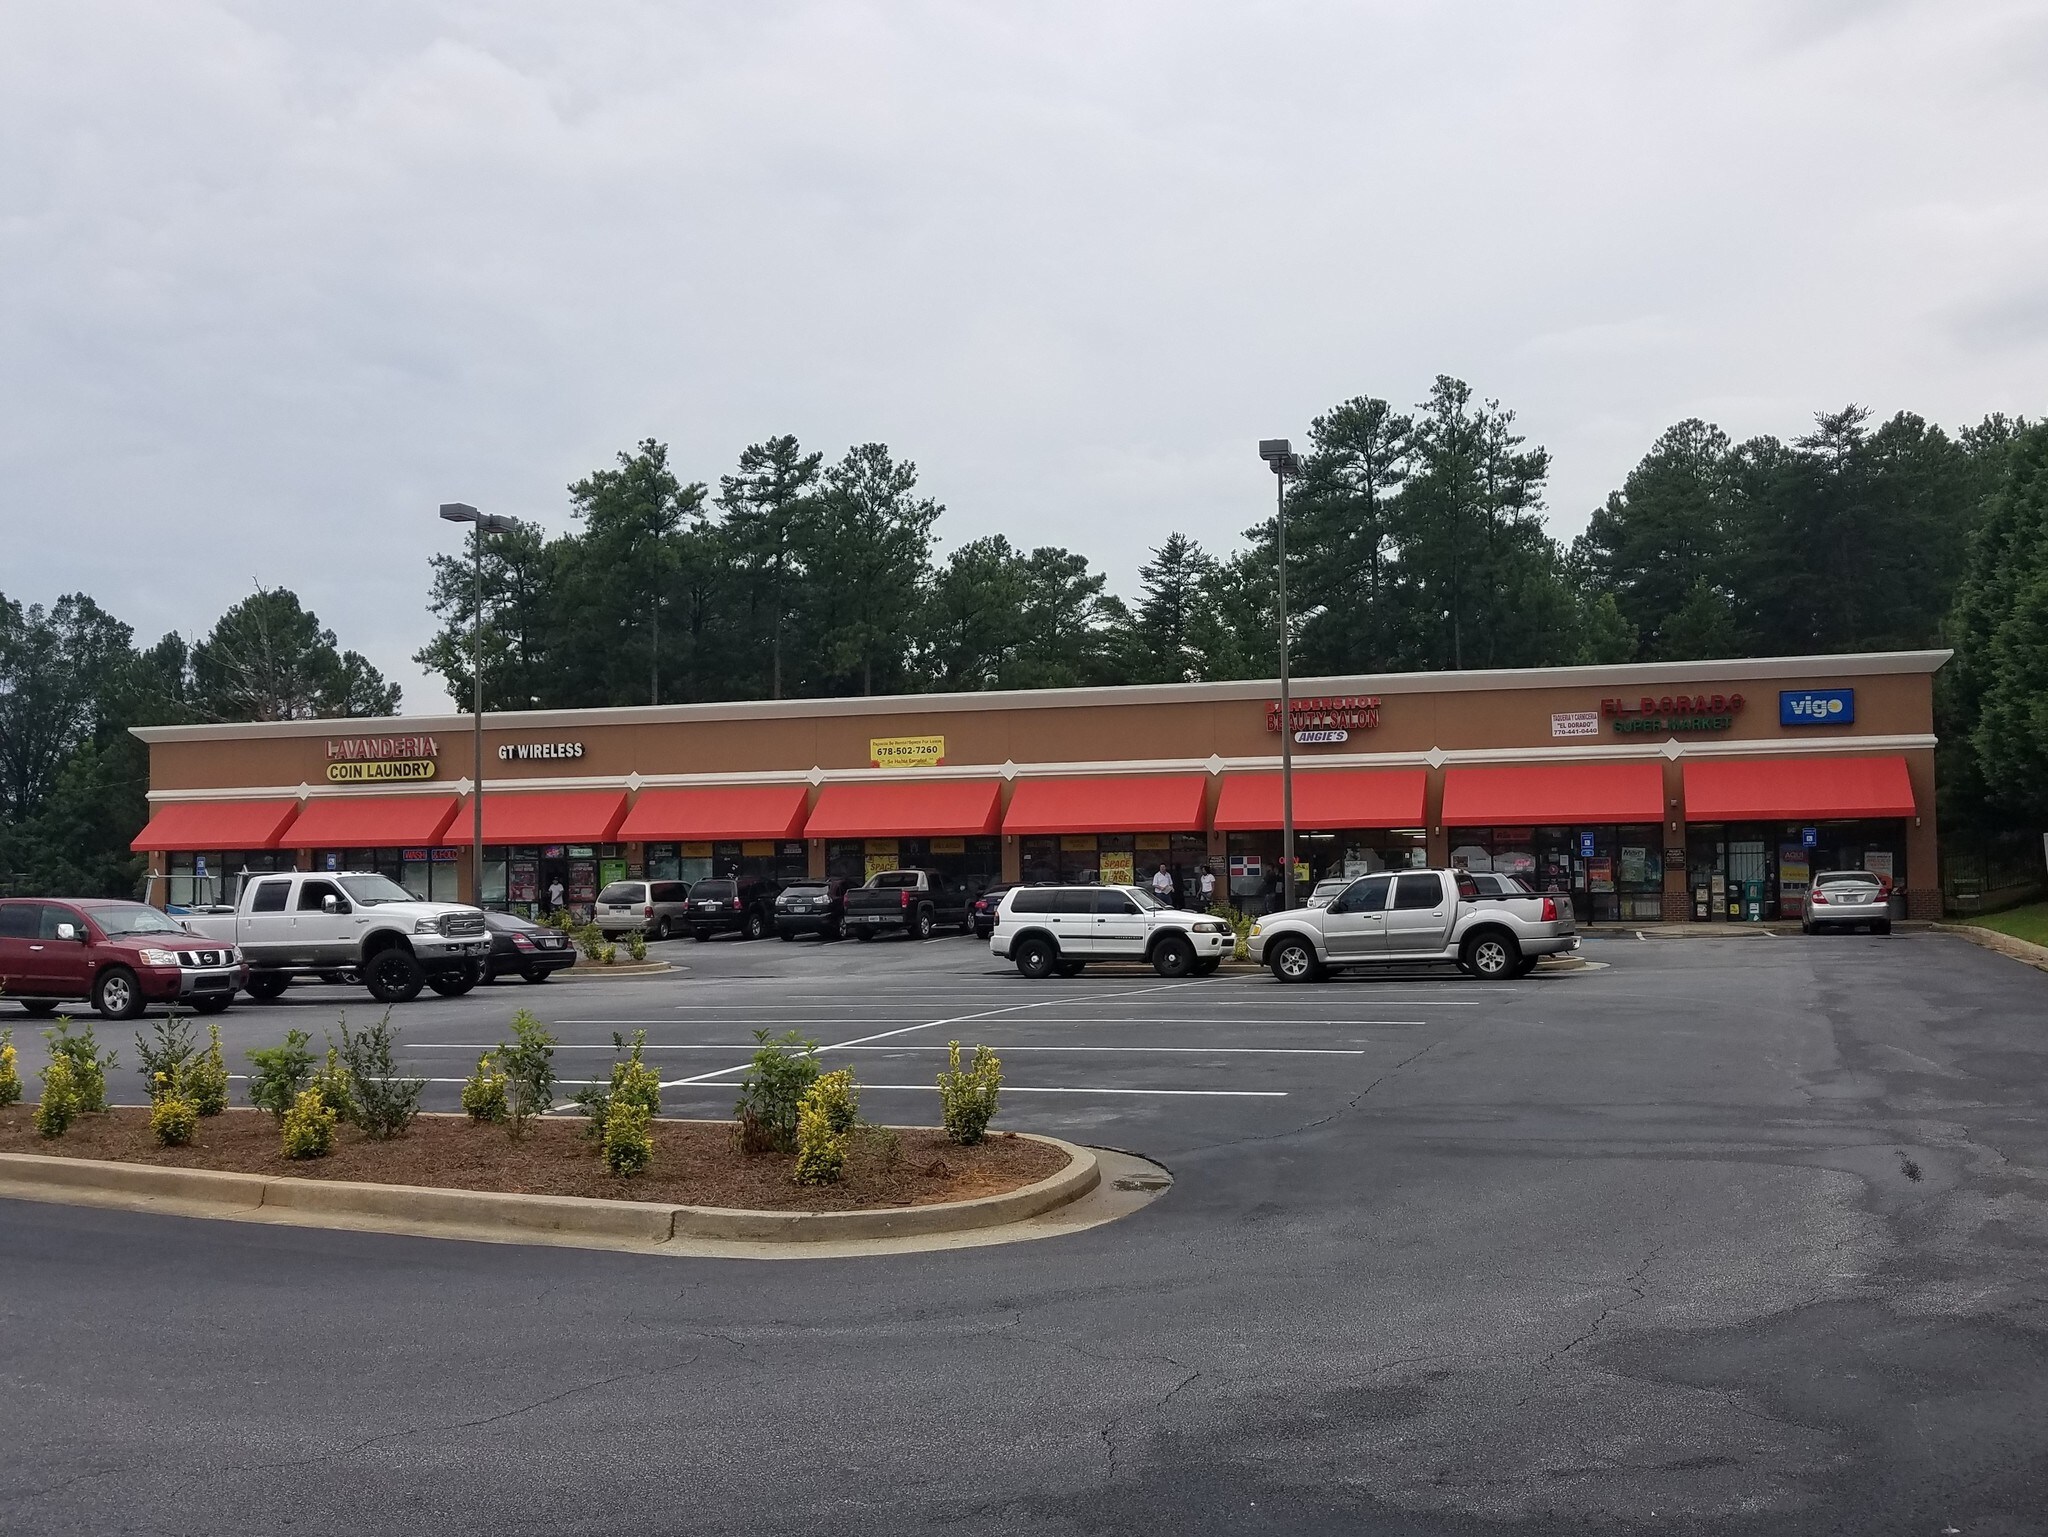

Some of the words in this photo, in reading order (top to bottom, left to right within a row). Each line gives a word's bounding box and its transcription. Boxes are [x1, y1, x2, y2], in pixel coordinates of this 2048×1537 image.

[1601, 699, 1630, 717] EL
[1640, 693, 1746, 716] DORADO
[1791, 696, 1843, 717] vigo
[1331, 710, 1379, 729] SALON
[1613, 719, 1660, 732] SUPER
[1667, 717, 1731, 730] MARKET
[1298, 731, 1344, 742] ANGIE'S
[325, 737, 438, 759] LAVANDERIA
[498, 745, 514, 759] GT
[517, 743, 583, 758] WIRELESS
[877, 746, 938, 755] 678-502-7260
[330, 765, 362, 779] COIN
[367, 762, 430, 778] LAUNDRY
[870, 863, 894, 871] SPACE
[1104, 860, 1131, 868] SPACE
[1279, 856, 1300, 864] ON
